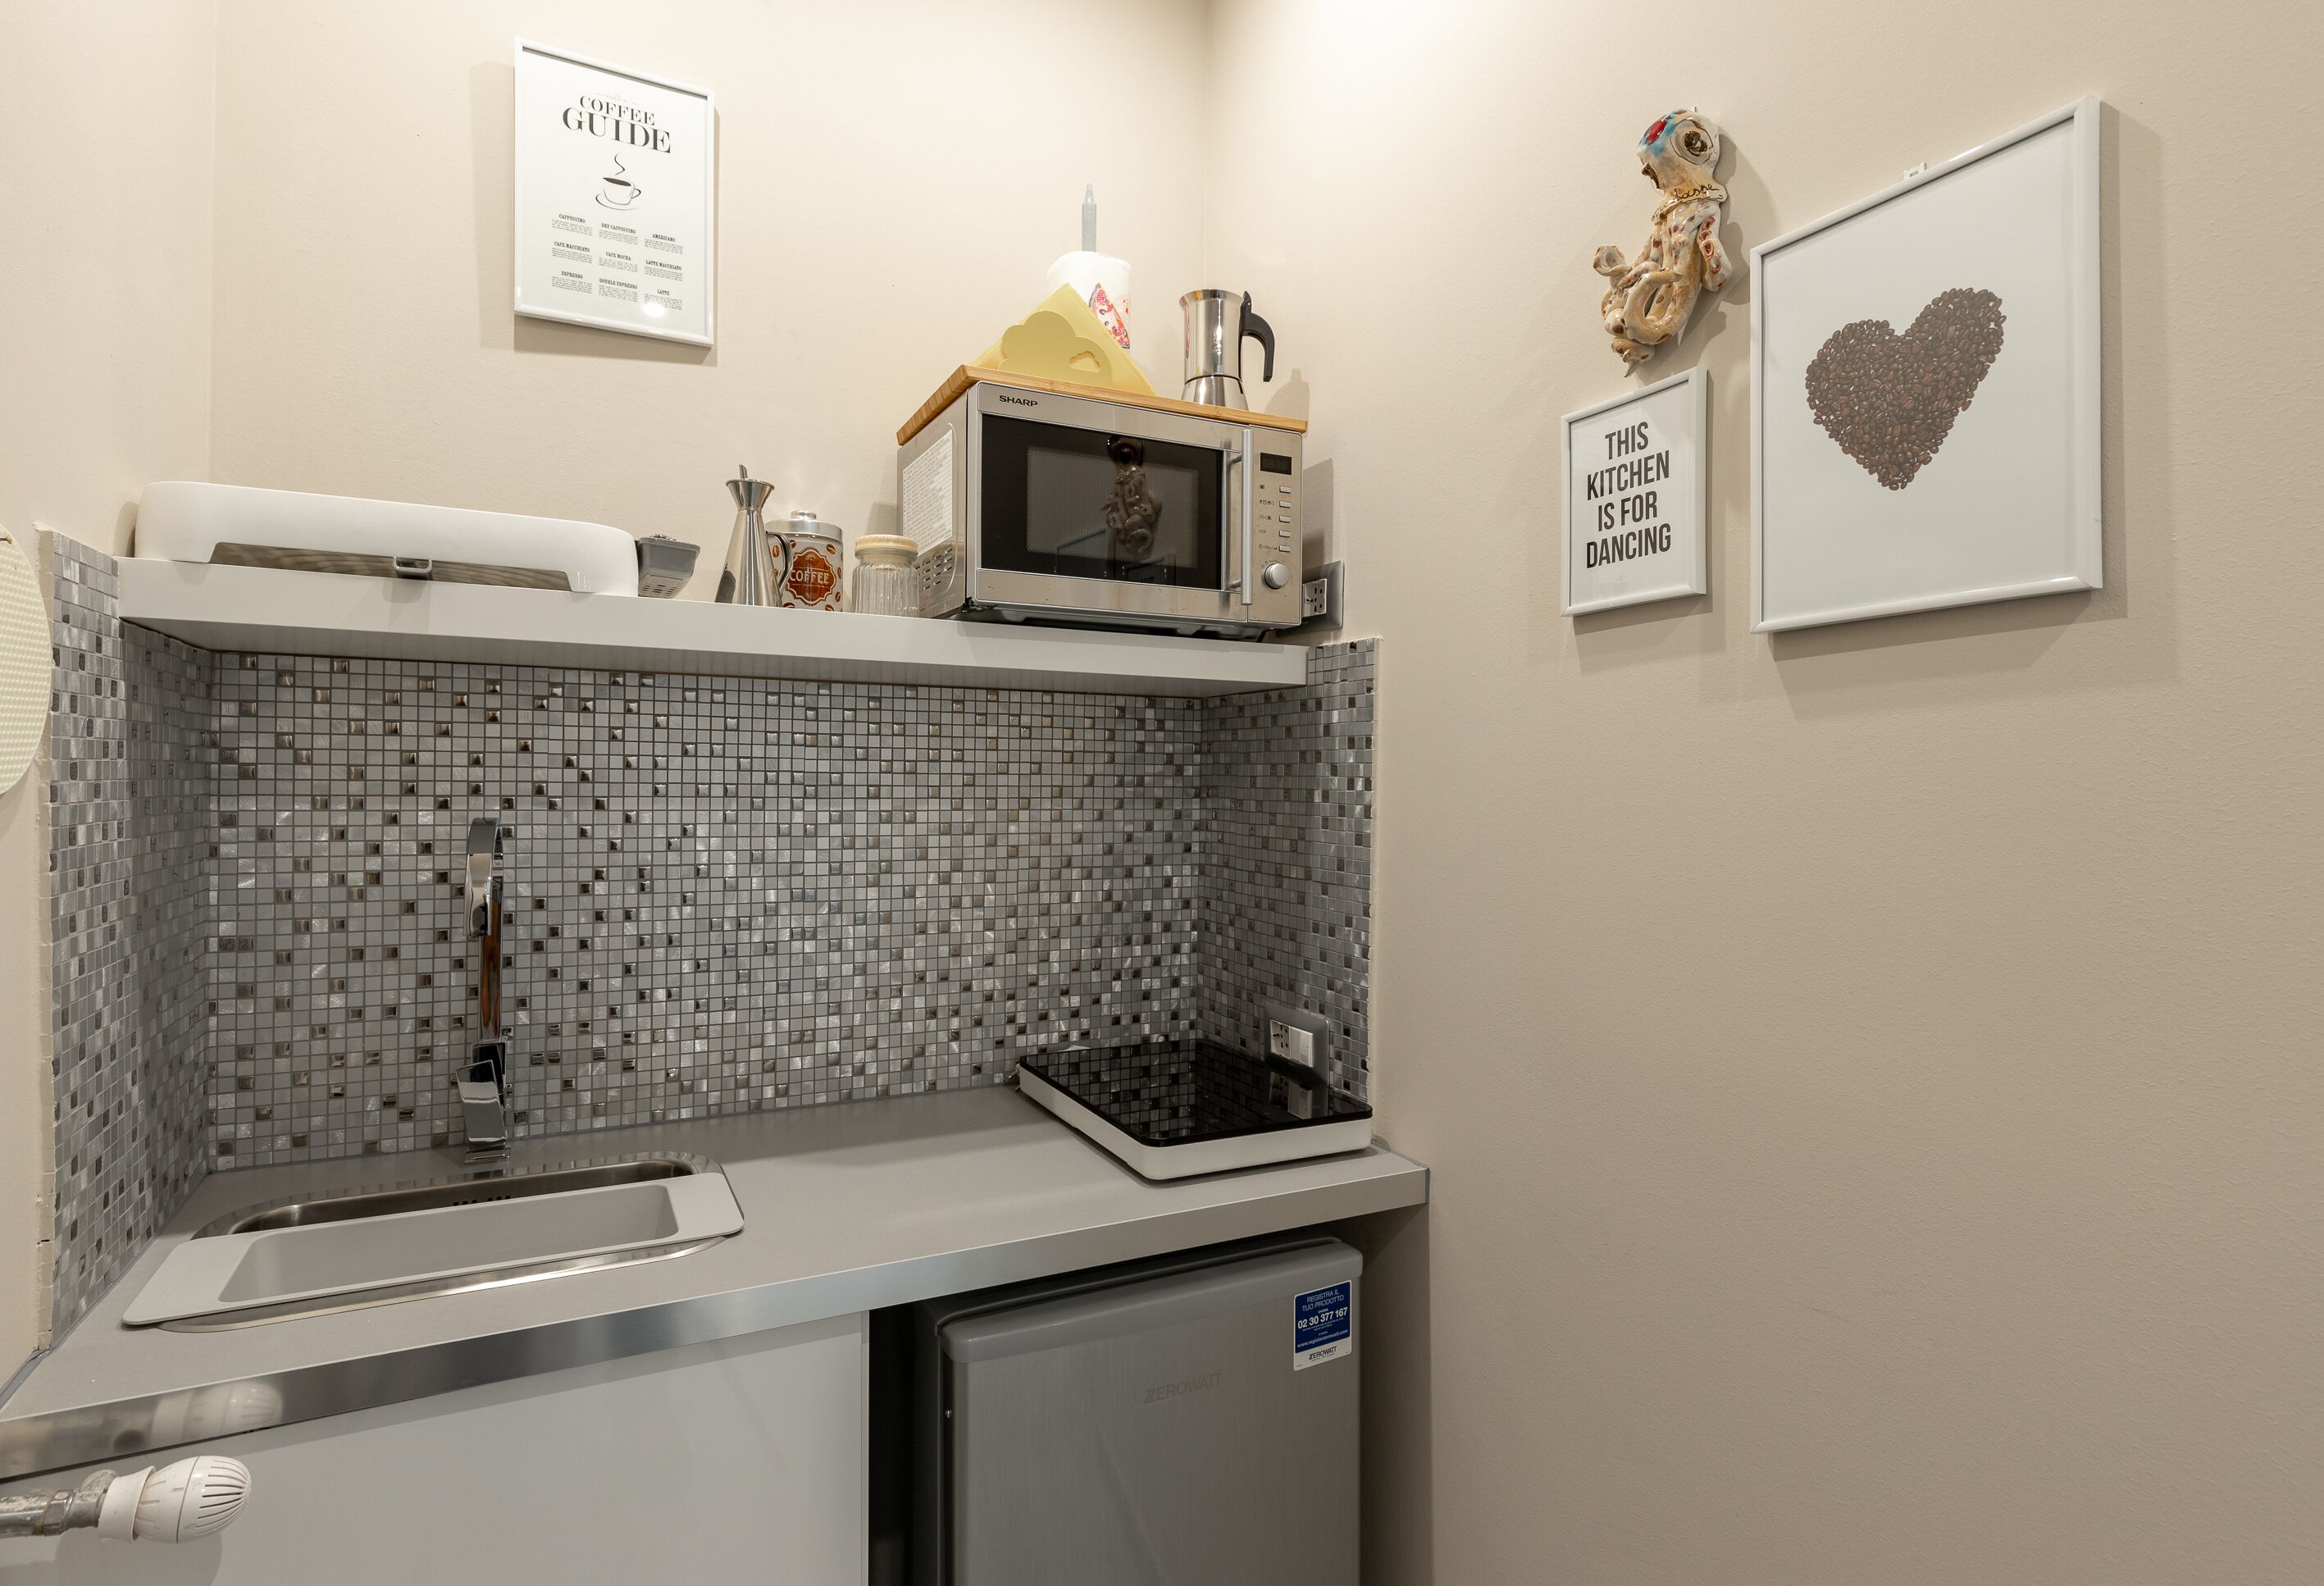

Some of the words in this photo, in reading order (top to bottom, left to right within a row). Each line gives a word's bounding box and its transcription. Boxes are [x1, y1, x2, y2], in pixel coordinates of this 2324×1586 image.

[580, 95, 655, 125] COFFEE
[563, 107, 671, 153] GUIDE
[558, 213, 586, 224] CAPPUCCINO
[610, 224, 636, 235] CAPPUCCINO
[652, 233, 676, 243] AMERICANO
[566, 243, 590, 253] MACCHIATO
[617, 253, 631, 261] MOCHA
[658, 262, 682, 271] MACCHIATO
[561, 271, 584, 280] ESPRESSO
[599, 277, 616, 286] DOUBLE
[616, 280, 638, 289] ESPRESSO
[999, 394, 1038, 407] SHARP
[1605, 421, 1649, 460] THIS
[1587, 449, 1670, 501] KITCHEN
[1597, 501, 1615, 532] IS
[1620, 490, 1657, 527] FOR
[1586, 522, 1671, 569] DANCING
[790, 570, 830, 584] COFFEE
[1307, 1291, 1333, 1302] REGISTRA
[1315, 1295, 1344, 1308] PRODOTTO
[1297, 1319, 1308, 1329] 02
[1309, 1315, 1319, 1326] 30
[1320, 1310, 1333, 1323] 377
[1335, 1306, 1347, 1318] 167
[1308, 1346, 1337, 1360] ZEROWATT
[1144, 1372, 1224, 1404] ZEROWATT
